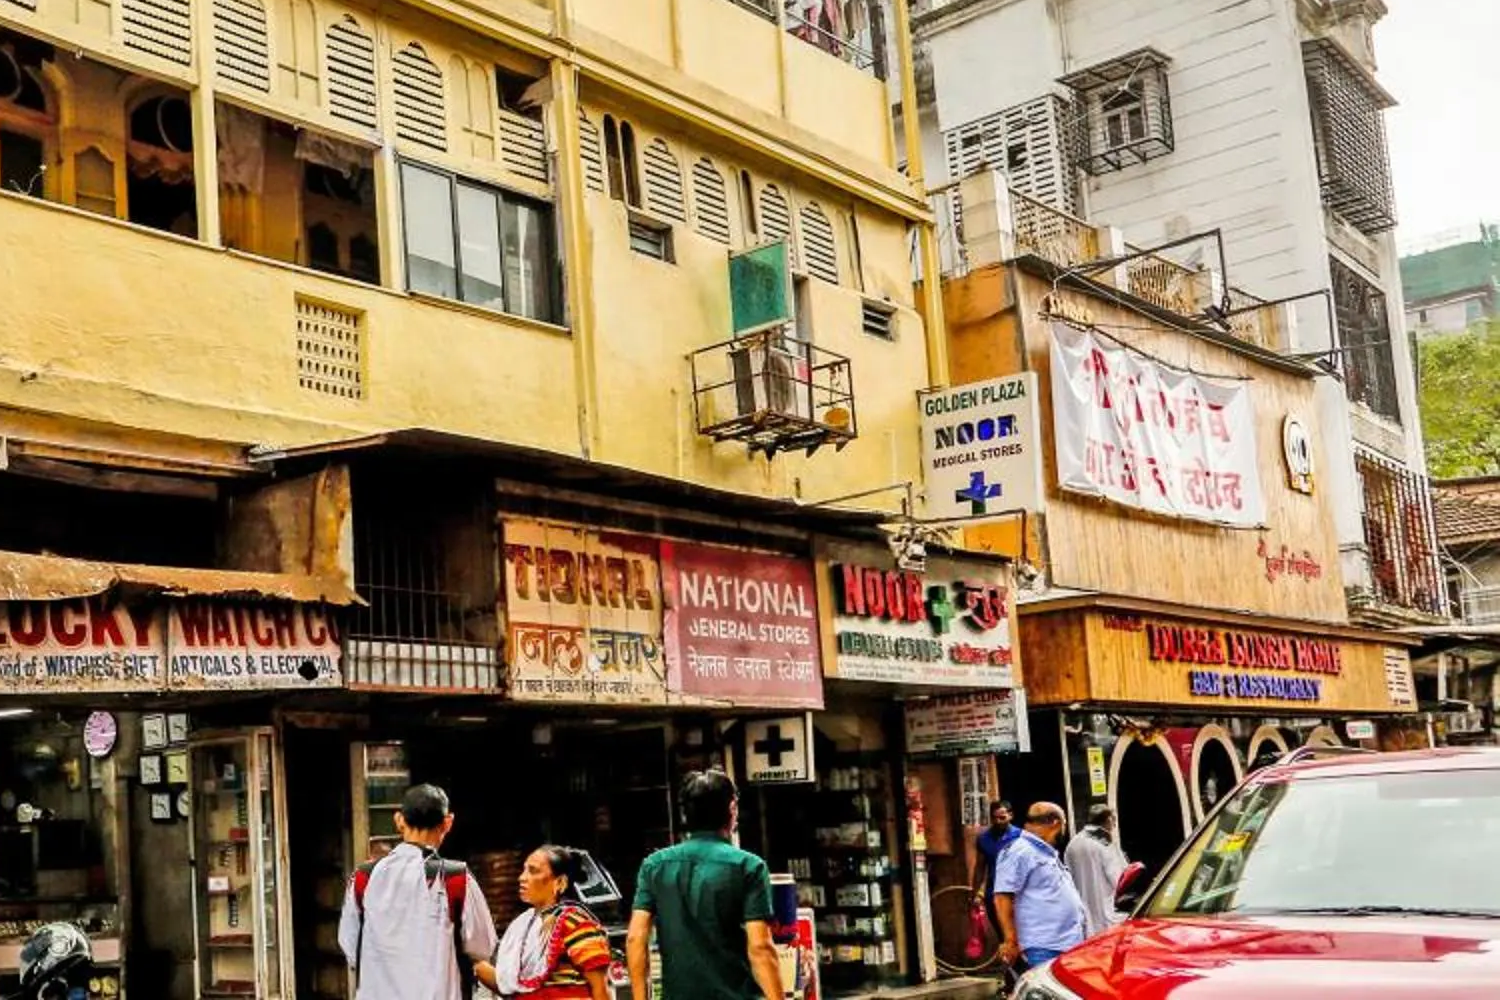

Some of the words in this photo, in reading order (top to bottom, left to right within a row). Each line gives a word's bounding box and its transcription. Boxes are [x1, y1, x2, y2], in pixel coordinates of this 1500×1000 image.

[925, 389, 978, 416] GOLDEN
[981, 379, 1026, 404] PLAZA
[934, 414, 1019, 450] NOOR
[933, 452, 978, 469] MEDICAL
[980, 443, 1023, 461] STORES
[680, 571, 813, 618] NATIONAL
[842, 563, 928, 625] NOOR
[179, 601, 297, 648] WATCH
[759, 623, 811, 645] STORES
[171, 655, 243, 677] ARTICALS
[246, 655, 258, 675] &
[752, 769, 798, 780] CHEMIST
